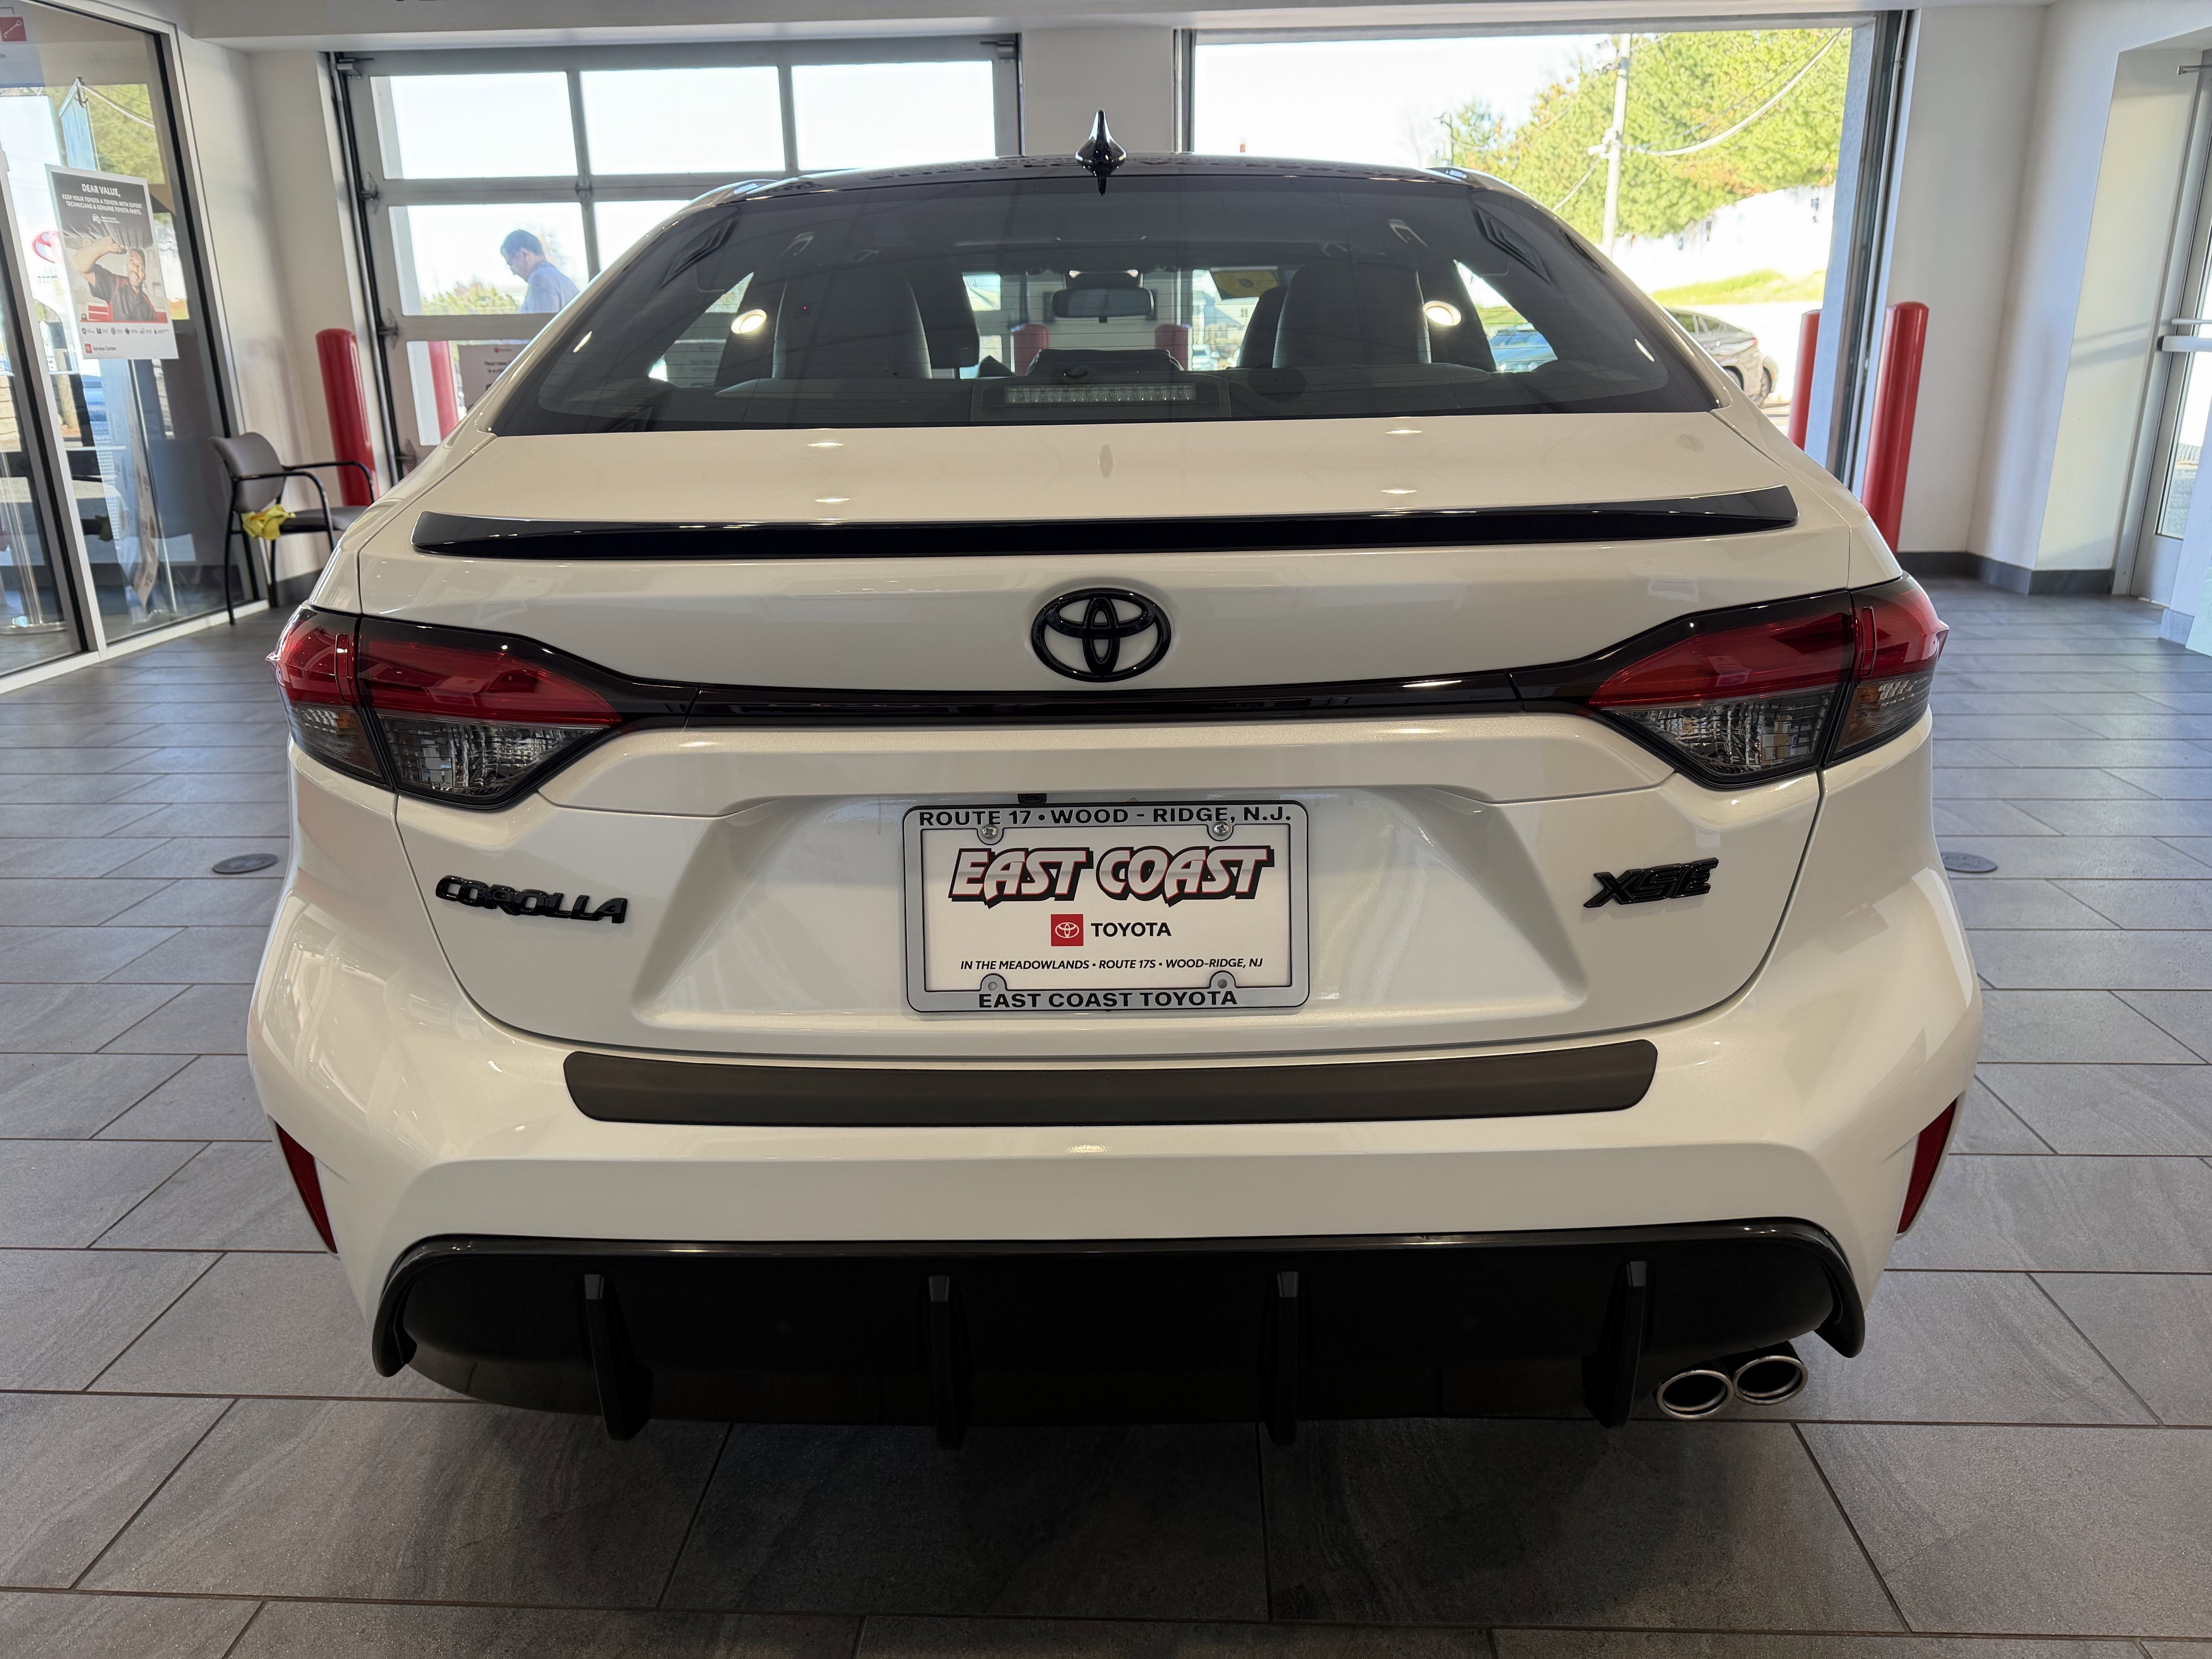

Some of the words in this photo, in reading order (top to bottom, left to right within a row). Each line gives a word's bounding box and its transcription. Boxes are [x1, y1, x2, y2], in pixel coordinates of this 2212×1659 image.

[82, 184, 99, 194] DEAR
[99, 186, 121, 198] VALUE,
[66, 201, 93, 210] TECHNICIANS
[920, 811, 1001, 826] ROUTE
[1009, 811, 1031, 824] 17
[1051, 809, 1128, 824] WOOD
[1153, 807, 1235, 823] RIDGE,
[1243, 807, 1291, 821] N.J.
[948, 847, 1094, 909] EAST
[1096, 845, 1274, 908] COAST
[1583, 857, 1719, 908] XSE
[436, 875, 628, 924] COROLLA
[1091, 922, 1172, 937] TOYOTA
[960, 960, 973, 969] IN
[975, 960, 996, 969] THE
[998, 960, 1089, 969] MEADOWLANDS
[1099, 960, 1136, 969] ROUTE
[1139, 959, 1156, 969] 17S
[1166, 958, 1246, 969] WOOD-RIDGE,
[1249, 958, 1263, 967] NJ
[979, 993, 1041, 1008] EAST
[1048, 993, 1133, 1008] COAST
[1139, 991, 1237, 1006] TOYOTA
